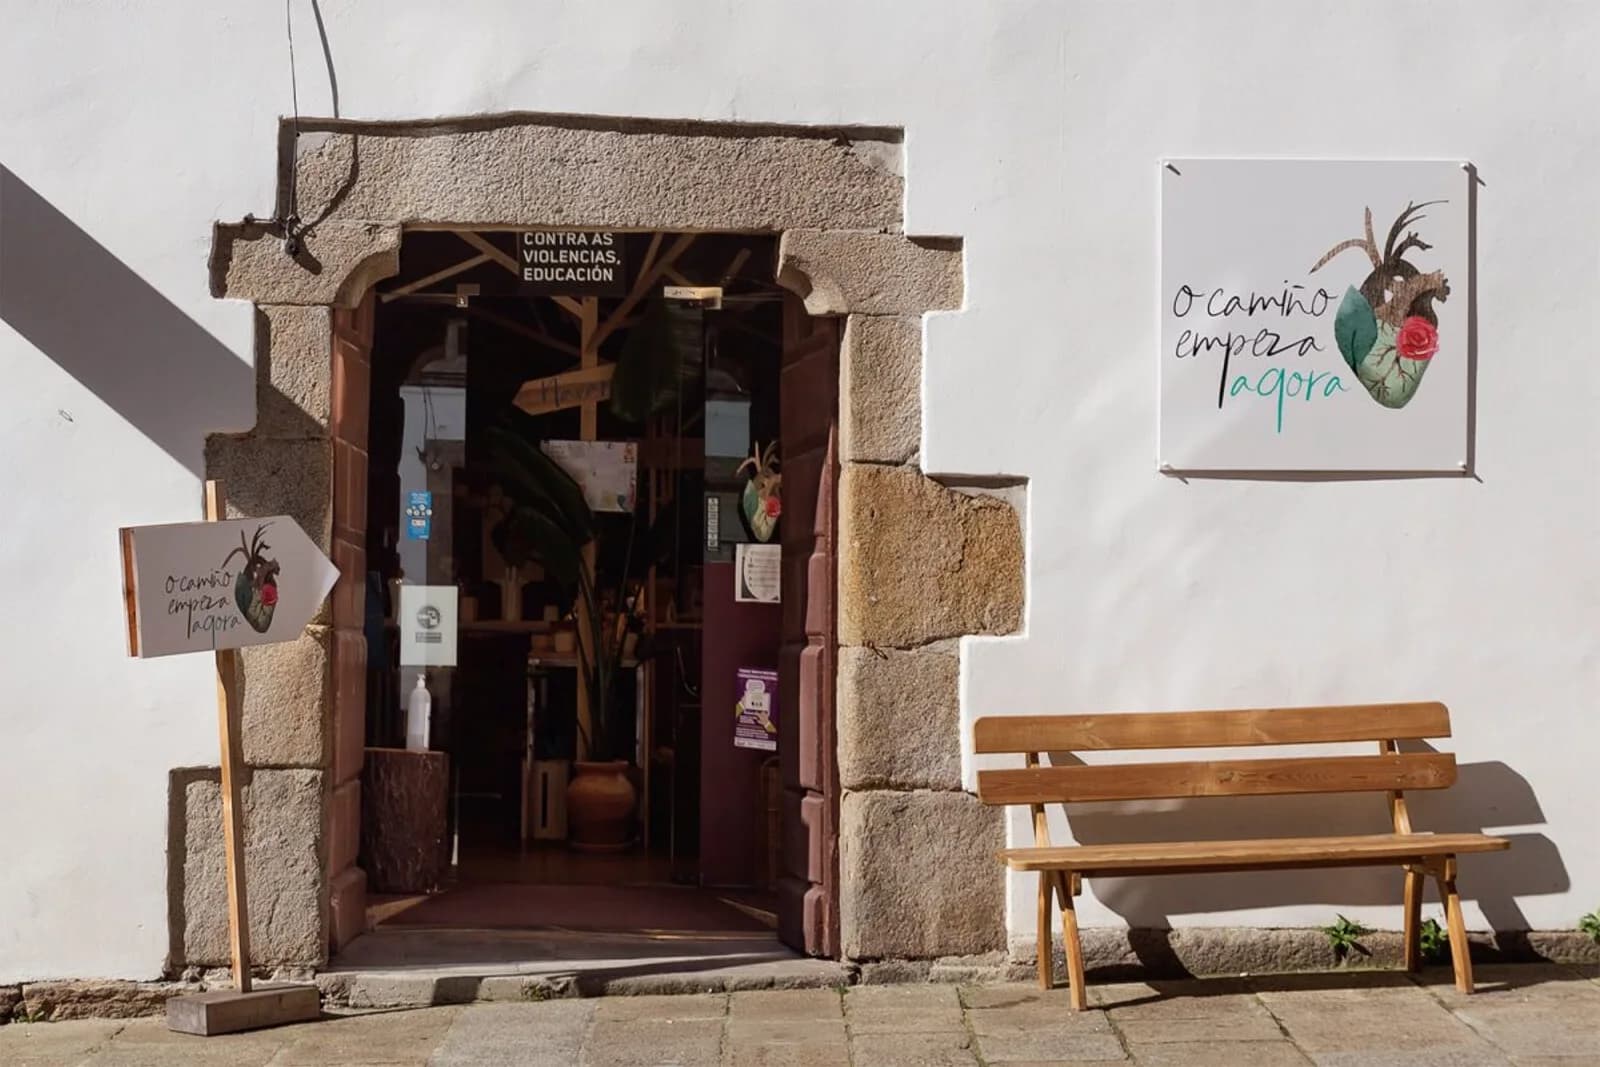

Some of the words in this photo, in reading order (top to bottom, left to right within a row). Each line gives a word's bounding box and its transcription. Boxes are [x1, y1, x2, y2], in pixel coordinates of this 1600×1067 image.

[523, 249, 621, 265] VIOLENCIAS,
[524, 232, 588, 246] CONTRA
[591, 232, 613, 246] AS
[523, 264, 613, 281] EDUCACIÓN
[1206, 280, 1338, 318] camiño
[1175, 328, 1326, 409] empeza
[1230, 367, 1352, 433] agora
[168, 595, 229, 639] empeza
[192, 614, 241, 649] agora
